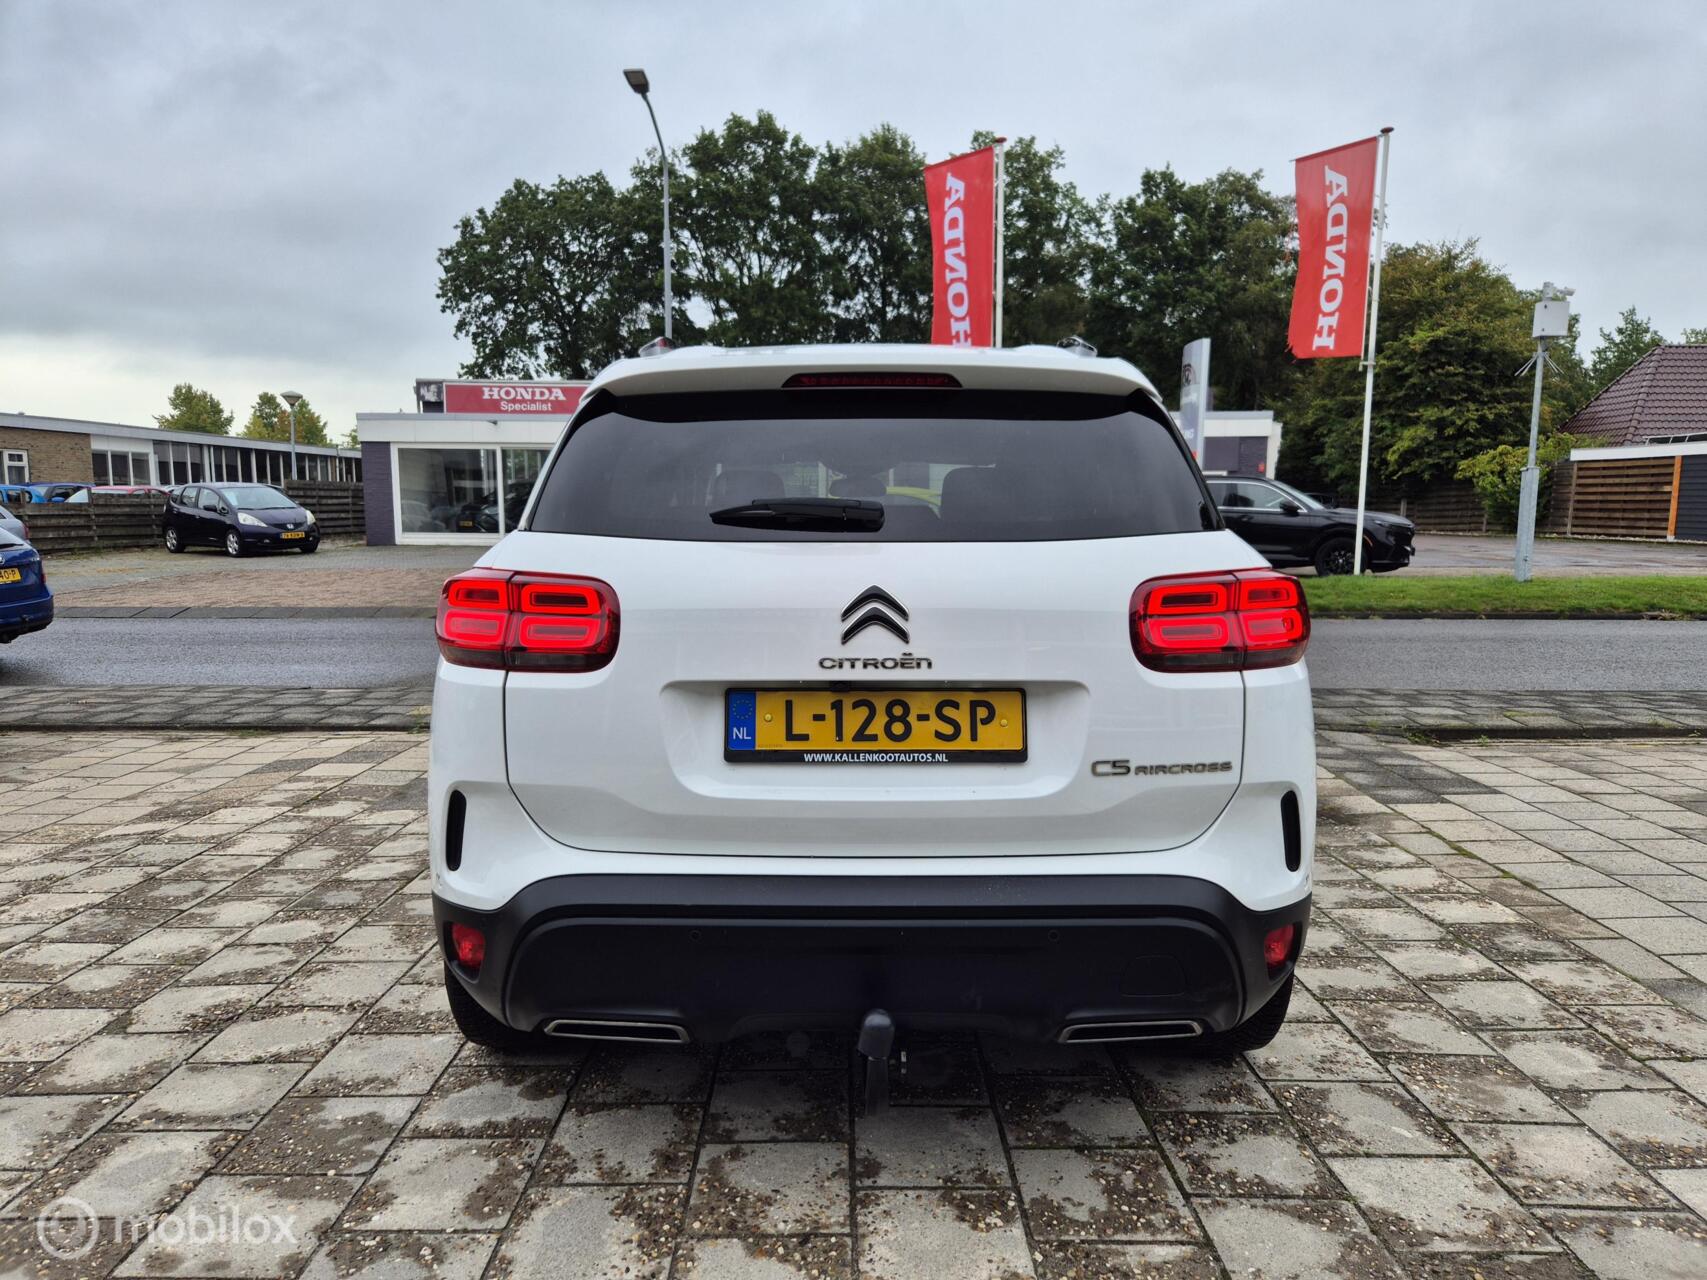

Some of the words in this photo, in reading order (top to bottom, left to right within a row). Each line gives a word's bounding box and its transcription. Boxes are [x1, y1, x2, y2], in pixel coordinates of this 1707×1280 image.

[943, 173, 972, 347] HONDA
[1312, 165, 1348, 350] HONDA
[482, 386, 566, 400] HONDA
[500, 400, 552, 411] Specialist
[785, 699, 996, 742] L-128-SP
[732, 727, 751, 740] NL
[804, 753, 949, 763] WWW.KALLENKOOTAUTOS.NL
[1091, 760, 1131, 777] C5
[1134, 761, 1232, 776] AIRCROSS
